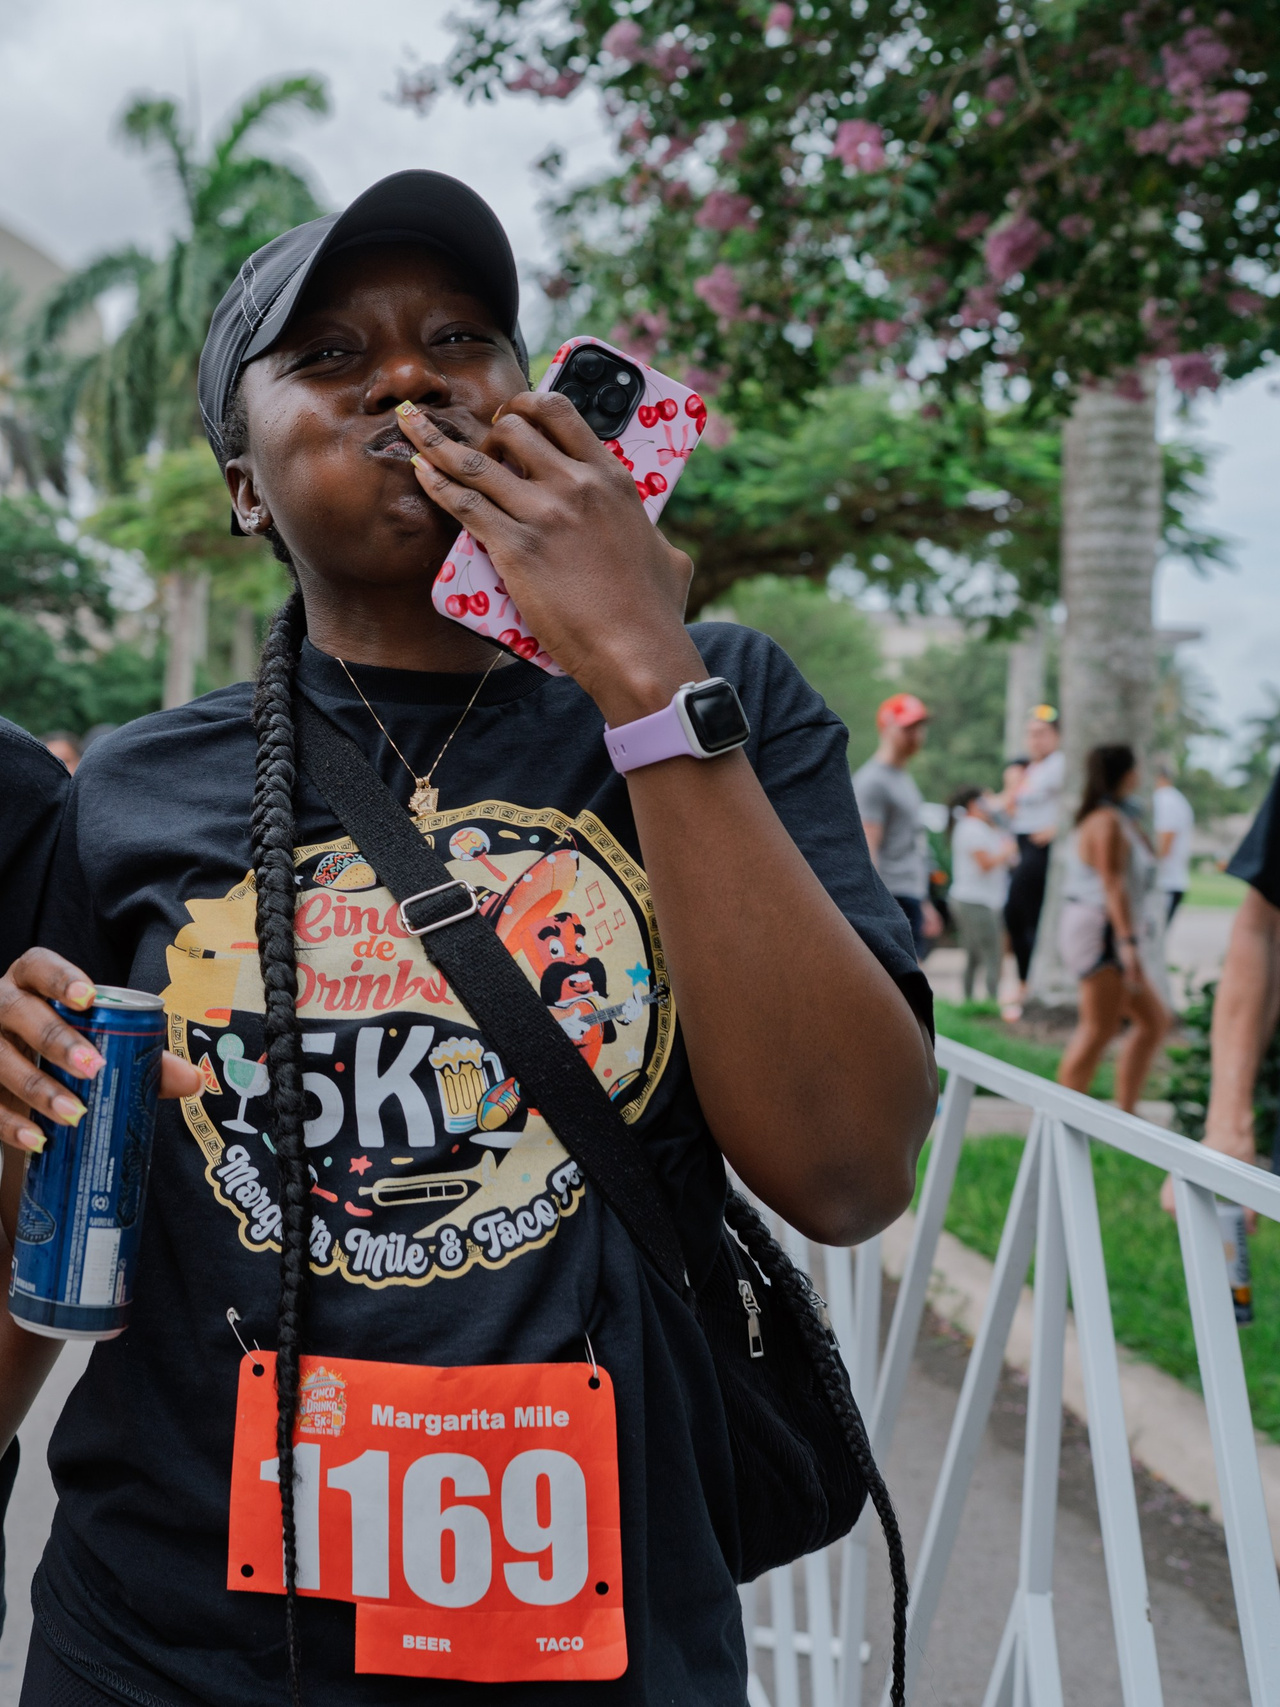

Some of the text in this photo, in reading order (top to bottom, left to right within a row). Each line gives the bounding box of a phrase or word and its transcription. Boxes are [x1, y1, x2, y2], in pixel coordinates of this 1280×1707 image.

[294, 892, 417, 944] Cinc
[353, 935, 397, 961] de
[300, 1025, 436, 1148] 5K
[217, 1144, 558, 1277] Margta Mile & Taco
[306, 1398, 338, 1413] DRINKO
[311, 1387, 336, 1400] CINCO
[371, 1404, 506, 1436] Margarita
[514, 1405, 570, 1428] Mile
[260, 1441, 589, 1609] 1169
[402, 1634, 584, 1653] BEER TACO
